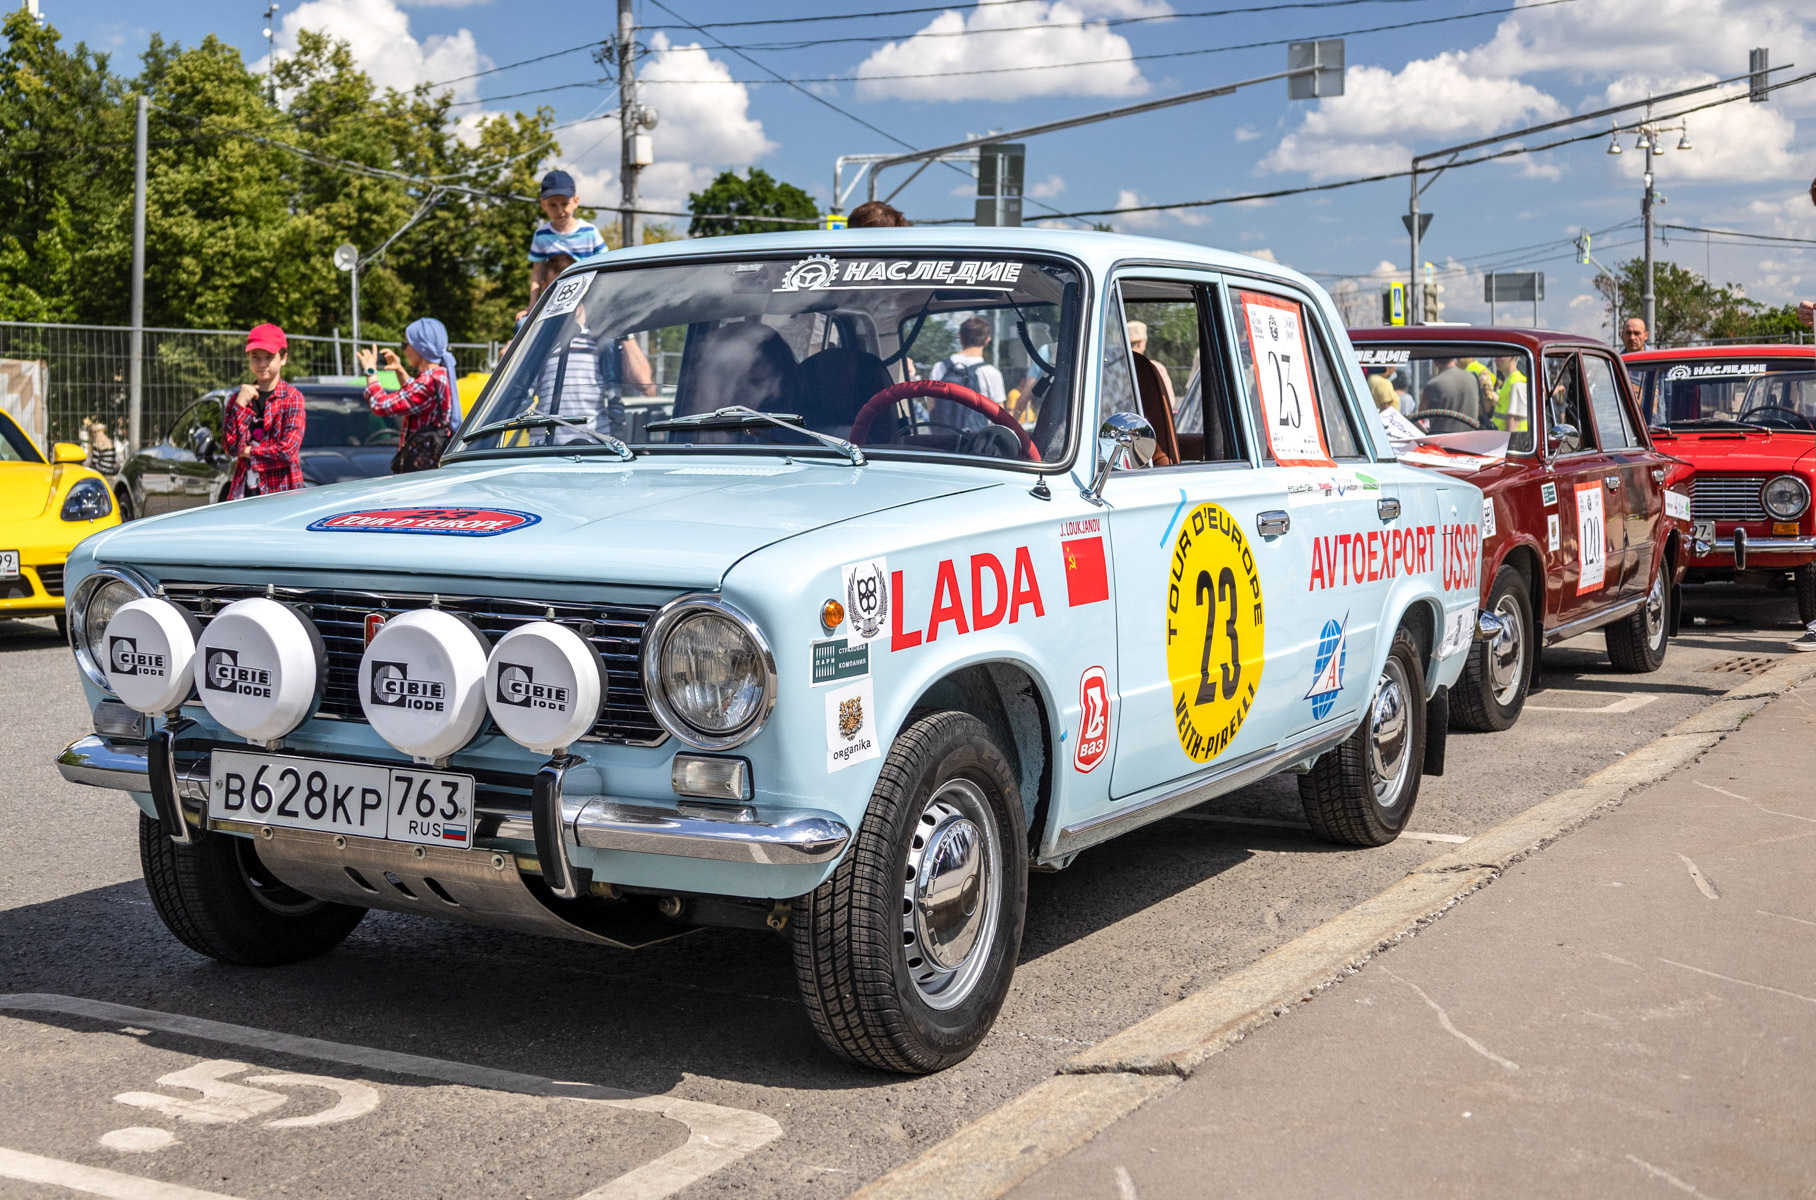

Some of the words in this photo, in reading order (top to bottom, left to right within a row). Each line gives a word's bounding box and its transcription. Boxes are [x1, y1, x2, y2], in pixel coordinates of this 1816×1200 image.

[842, 261, 1023, 284] НАСЛЕДИЕ
[1693, 364, 1767, 375] НАСЛЕДИЕ
[332, 515, 391, 525] TOUR
[402, 510, 479, 520] 23
[1066, 518, 1100, 536] LOUKJANOV
[1584, 516, 1600, 565] 120
[1309, 525, 1435, 591] AVTOEXPORT
[1442, 524, 1478, 591] USSR
[1168, 529, 1192, 645] TOUR
[1192, 507, 1262, 628] D'EUROPE
[891, 545, 1045, 652] LADA
[1194, 566, 1241, 706] 23
[815, 658, 835, 666] ПАРИ
[838, 657, 867, 669] КОМПАНИЯ
[139, 667, 164, 676] IODE
[238, 684, 271, 698] IODE
[407, 698, 444, 712] IODE
[533, 699, 566, 712] IODE
[1175, 682, 1255, 760] VEITH-PIRELLI
[224, 764, 382, 826] В628КР
[394, 776, 459, 820] 763
[409, 820, 441, 837] RUS
